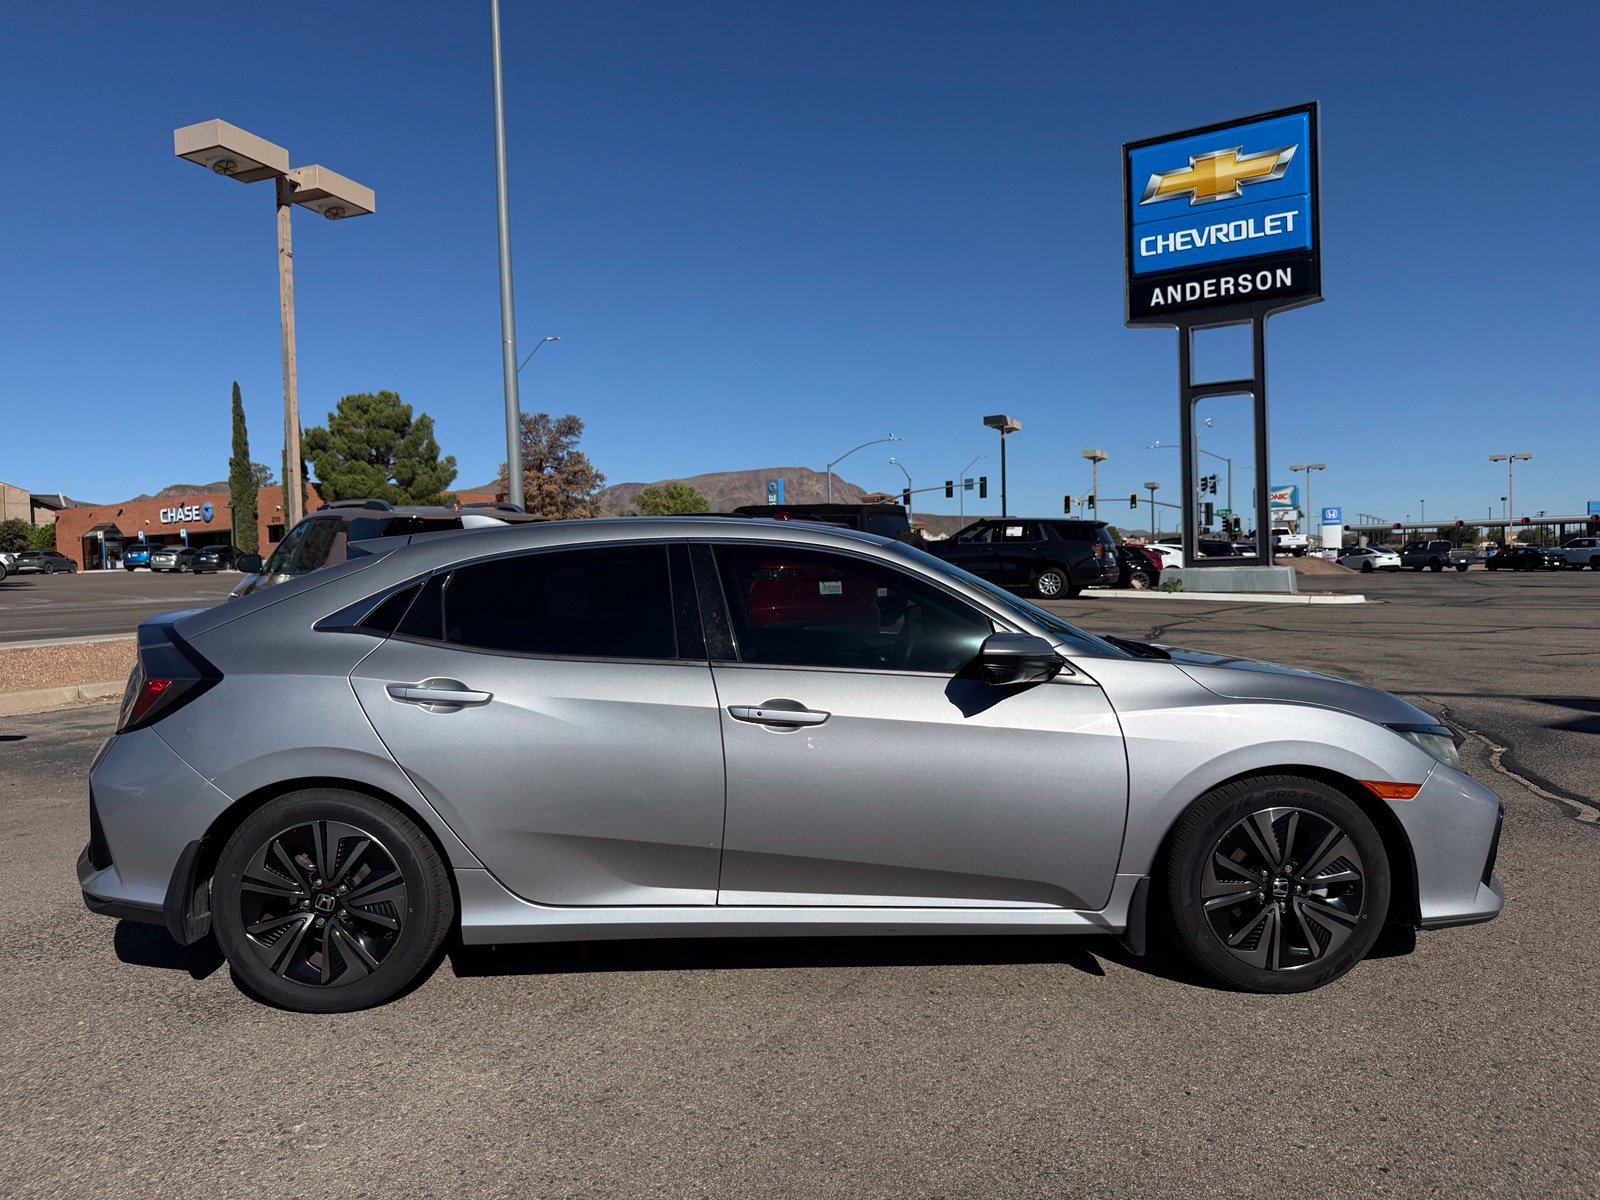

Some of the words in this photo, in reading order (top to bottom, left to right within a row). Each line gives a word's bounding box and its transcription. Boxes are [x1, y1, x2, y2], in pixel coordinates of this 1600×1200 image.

[1140, 210, 1299, 257] CHEVROLET
[1149, 267, 1293, 307] ANDERSON
[159, 504, 201, 524] CHASE
[1265, 790, 1298, 800] PRO
